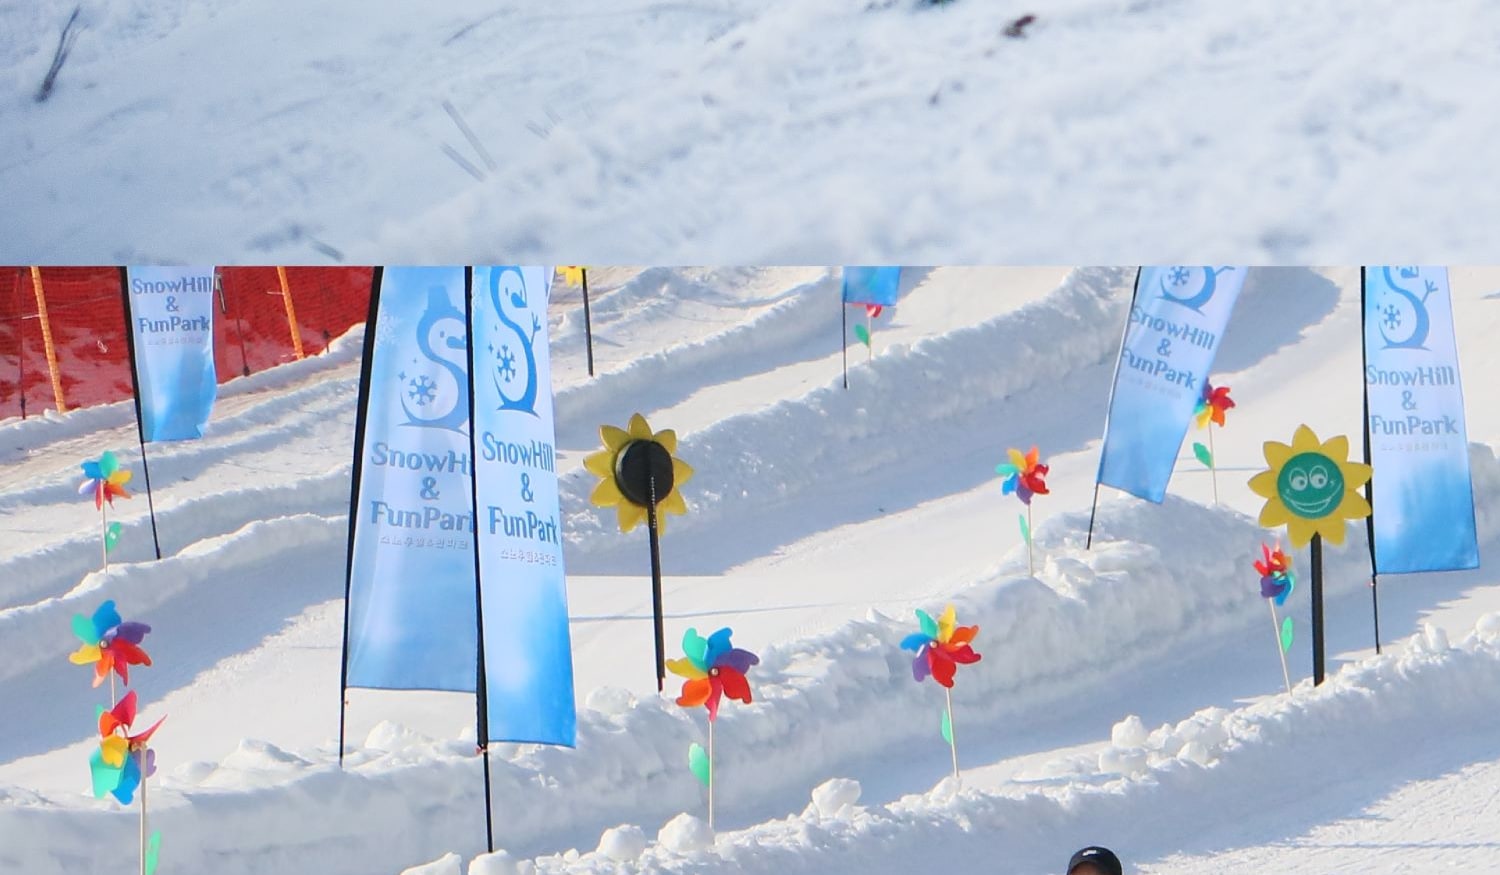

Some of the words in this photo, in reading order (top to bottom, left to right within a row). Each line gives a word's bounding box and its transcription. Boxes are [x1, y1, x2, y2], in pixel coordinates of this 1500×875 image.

[132, 276, 212, 294] SnowHill
[166, 296, 179, 312] &
[139, 316, 210, 333] FunPark
[1131, 305, 1215, 350] SnowHill
[1157, 338, 1172, 357] &
[1367, 364, 1455, 386] SnowHill
[1401, 390, 1417, 411] &
[1370, 415, 1459, 435] FunPark
[482, 431, 554, 473] SnowHill
[420, 477, 440, 500] &
[521, 472, 535, 503] &
[488, 505, 558, 545] FunPark
